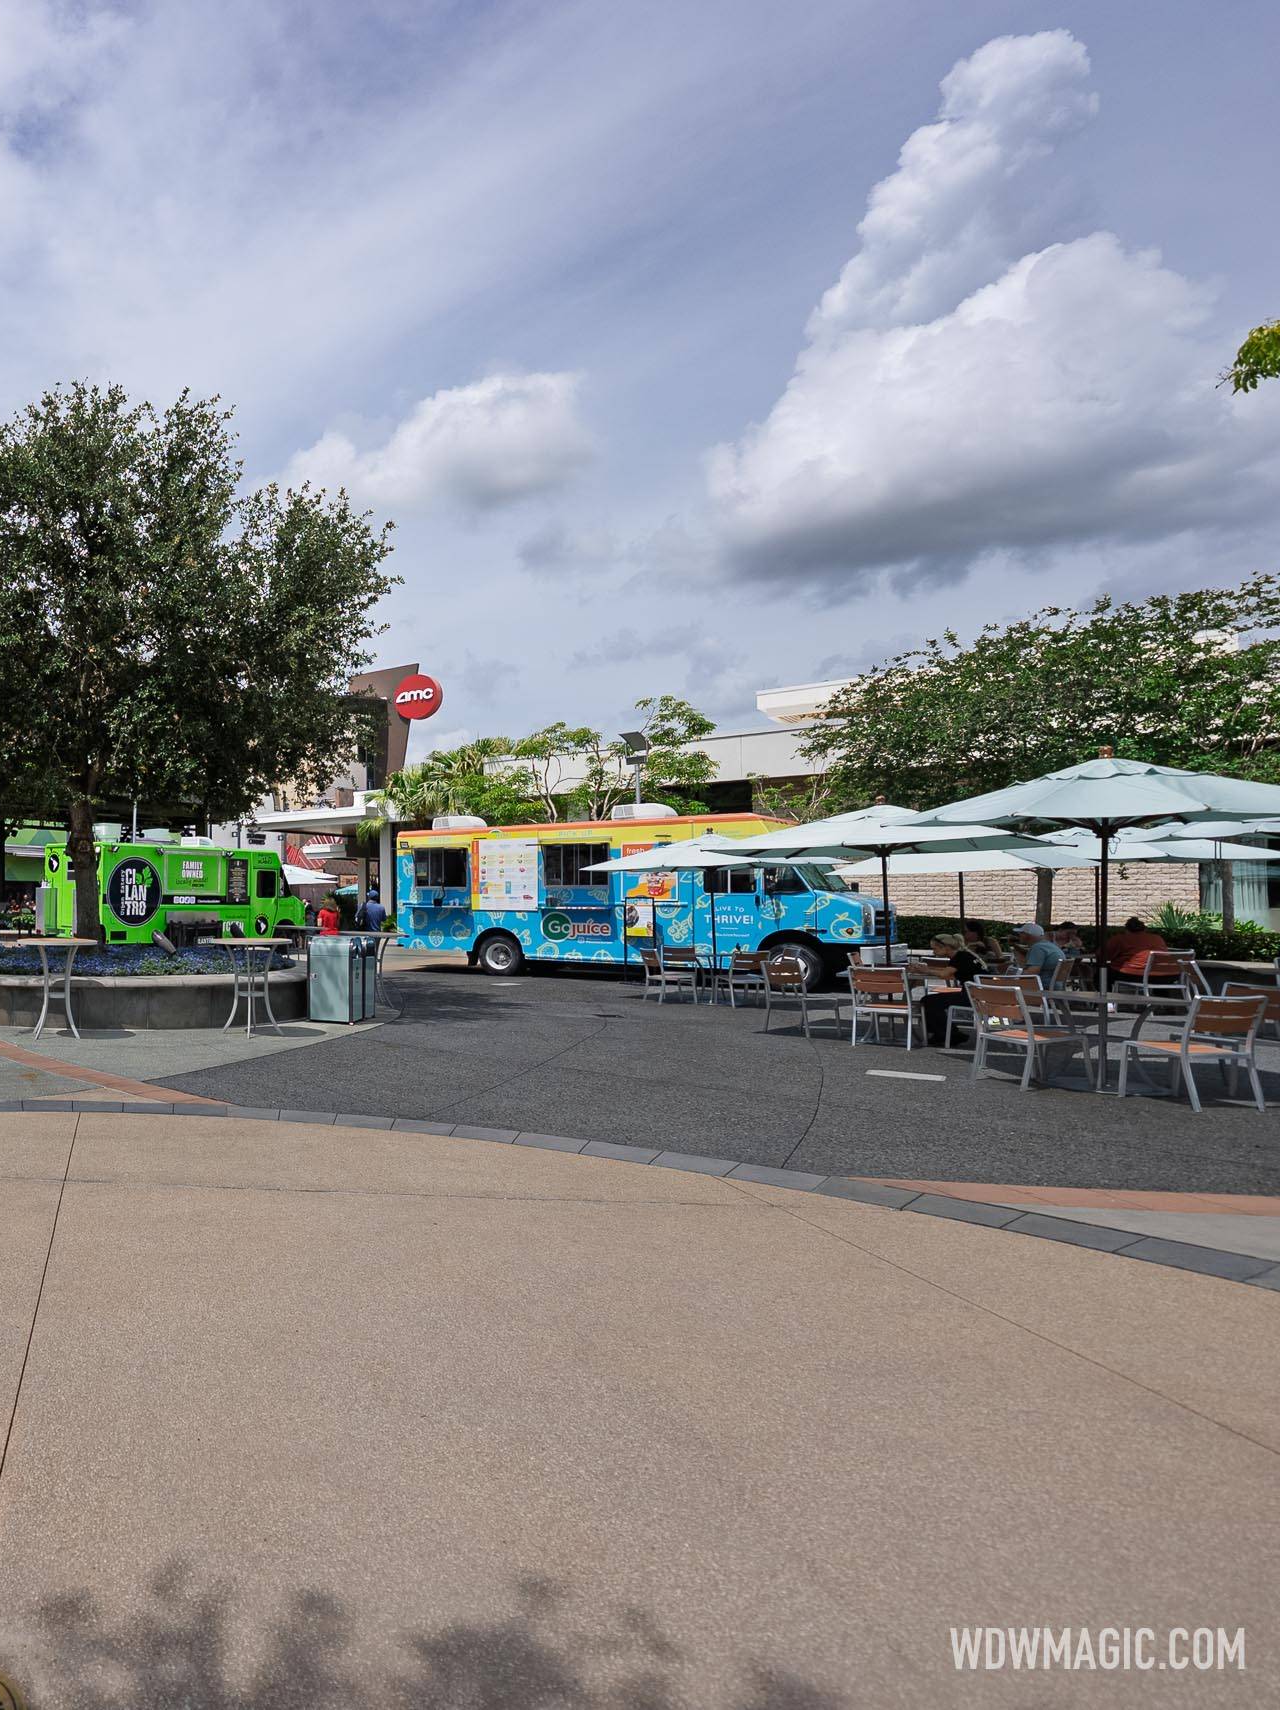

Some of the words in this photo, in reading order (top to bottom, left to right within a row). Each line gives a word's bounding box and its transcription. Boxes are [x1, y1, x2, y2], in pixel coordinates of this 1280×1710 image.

[182, 860, 203, 870] FAMILY
[125, 868, 136, 885] CI
[124, 884, 147, 901] LAN
[124, 900, 147, 916] TRO
[734, 905, 745, 913] TO
[704, 914, 754, 925] THRIVE!
